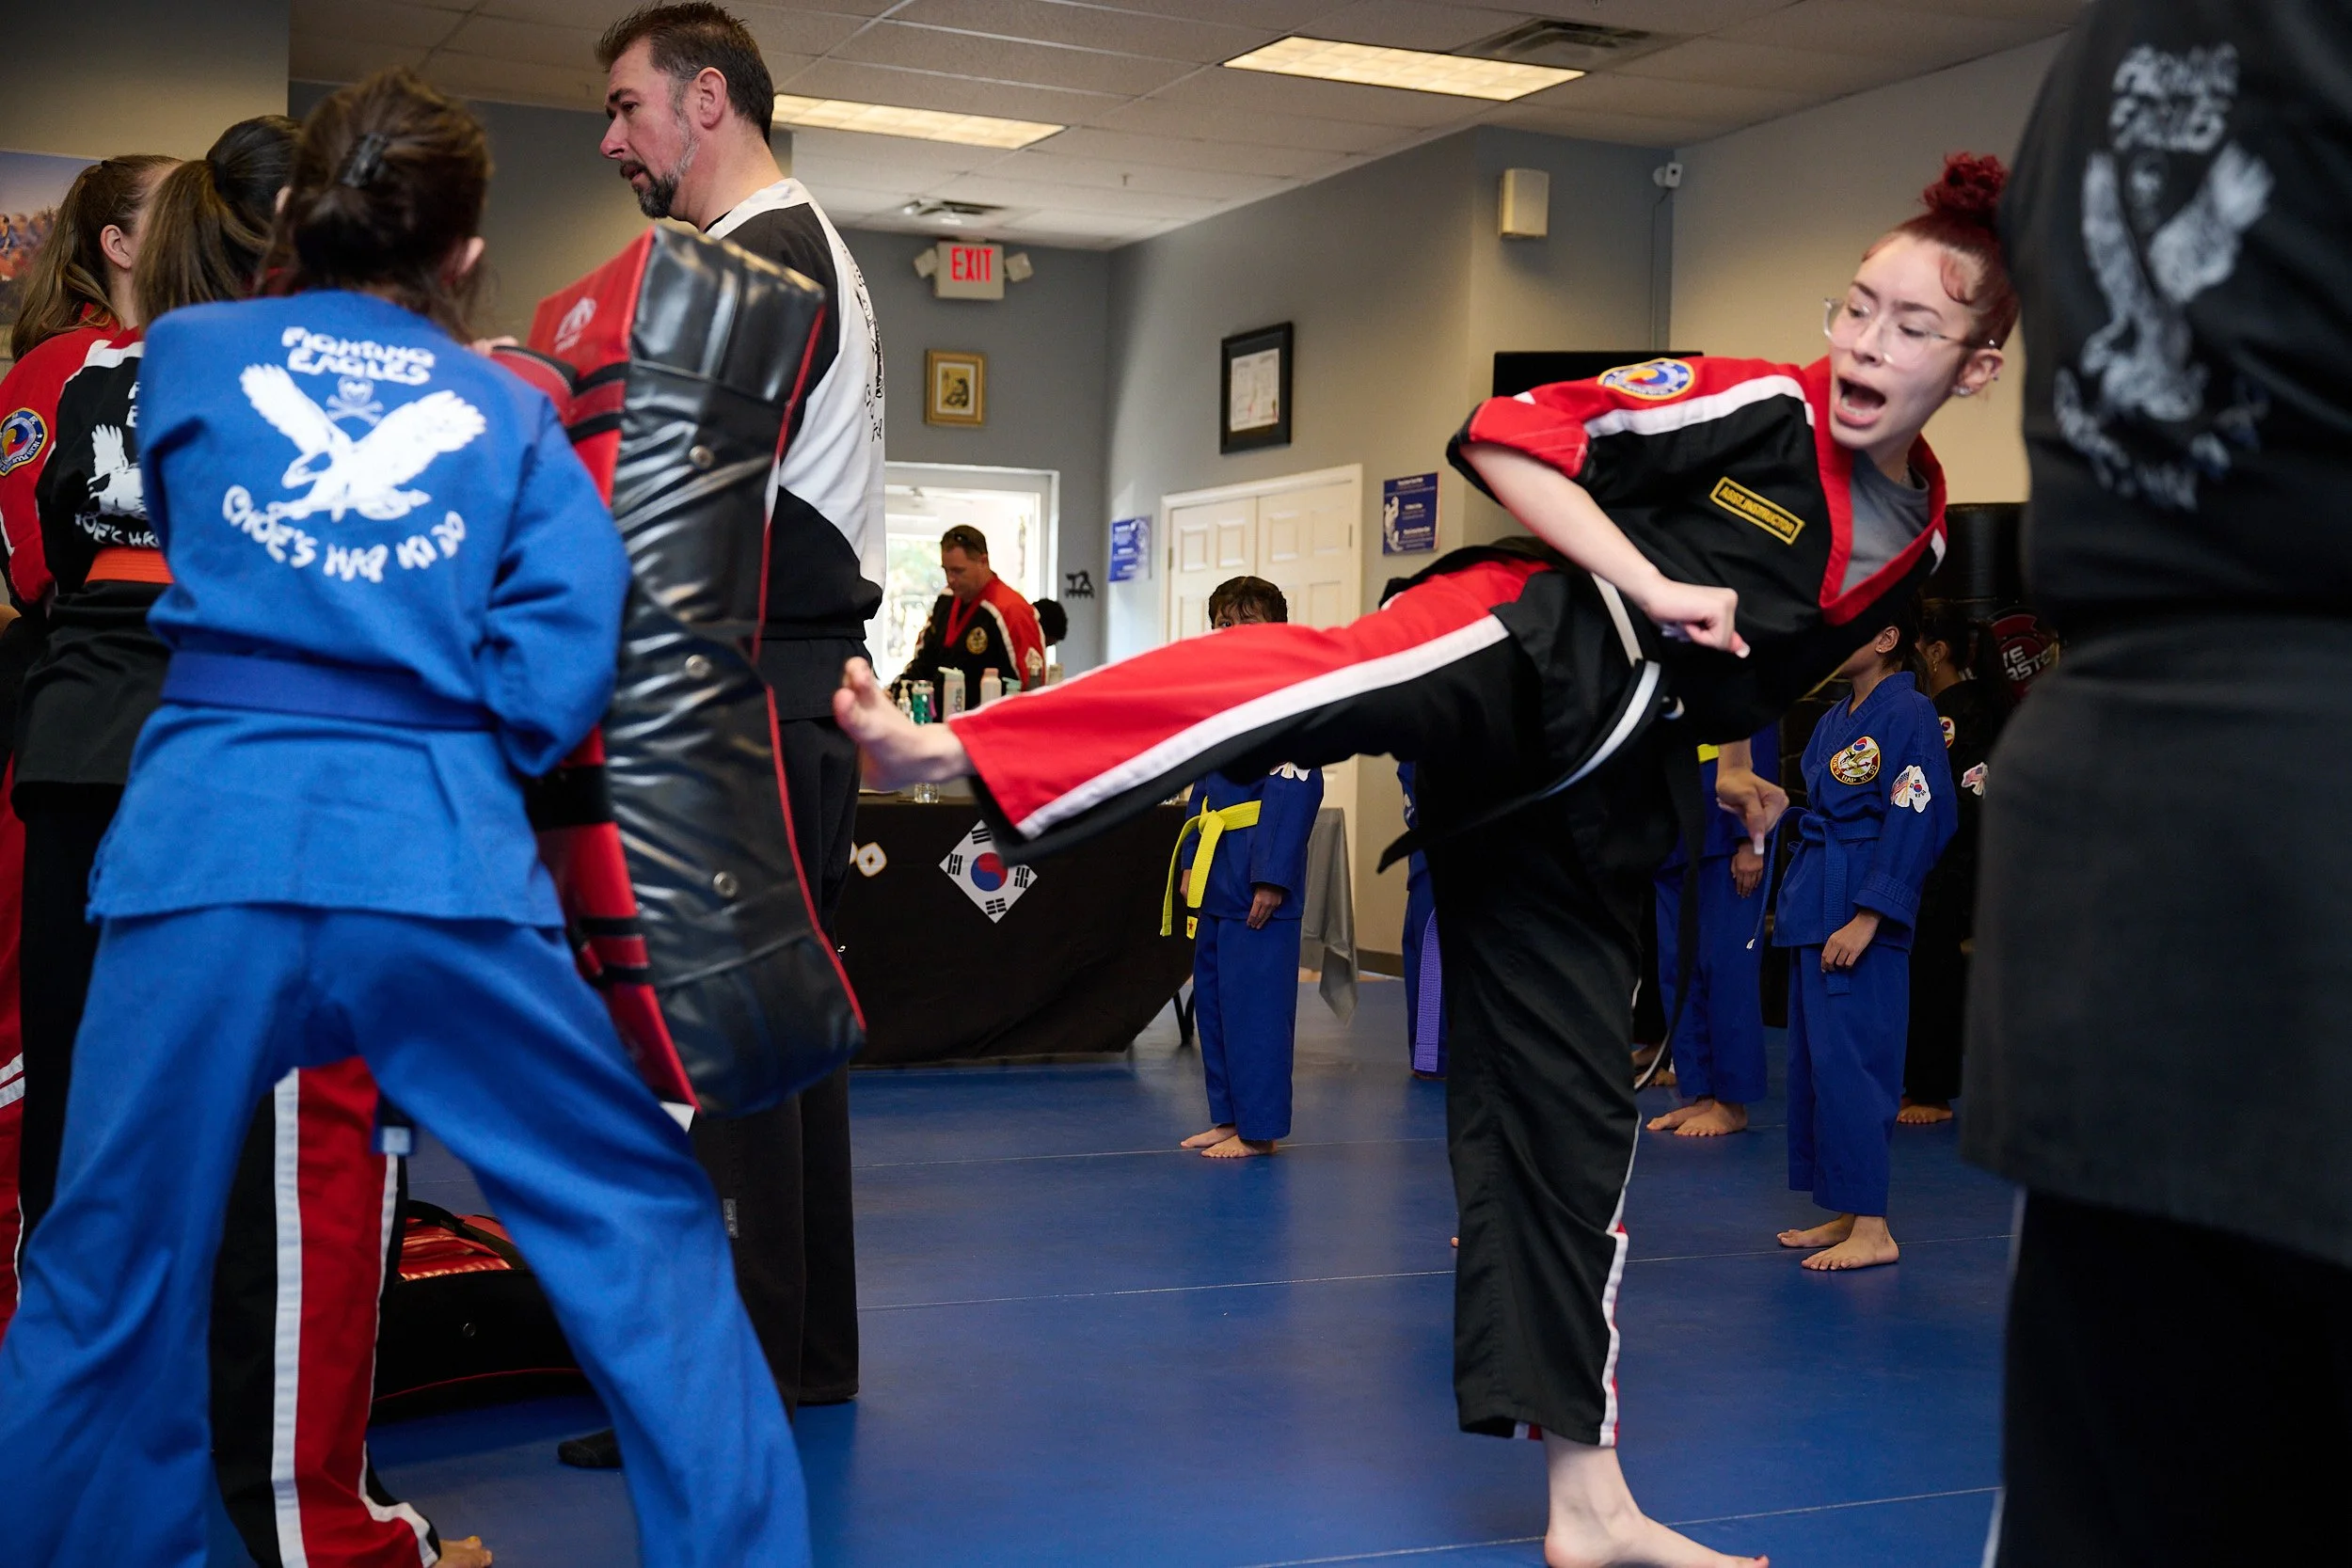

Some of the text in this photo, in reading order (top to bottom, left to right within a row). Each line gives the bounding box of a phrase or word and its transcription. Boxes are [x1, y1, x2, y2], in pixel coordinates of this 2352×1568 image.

[951, 246, 993, 283] EXIT
[287, 347, 431, 386] EAGLES
[323, 543, 389, 582] HAP
[396, 534, 437, 569] KI
[1841, 774, 1856, 784] HAP
[1868, 765, 1878, 775] DO
